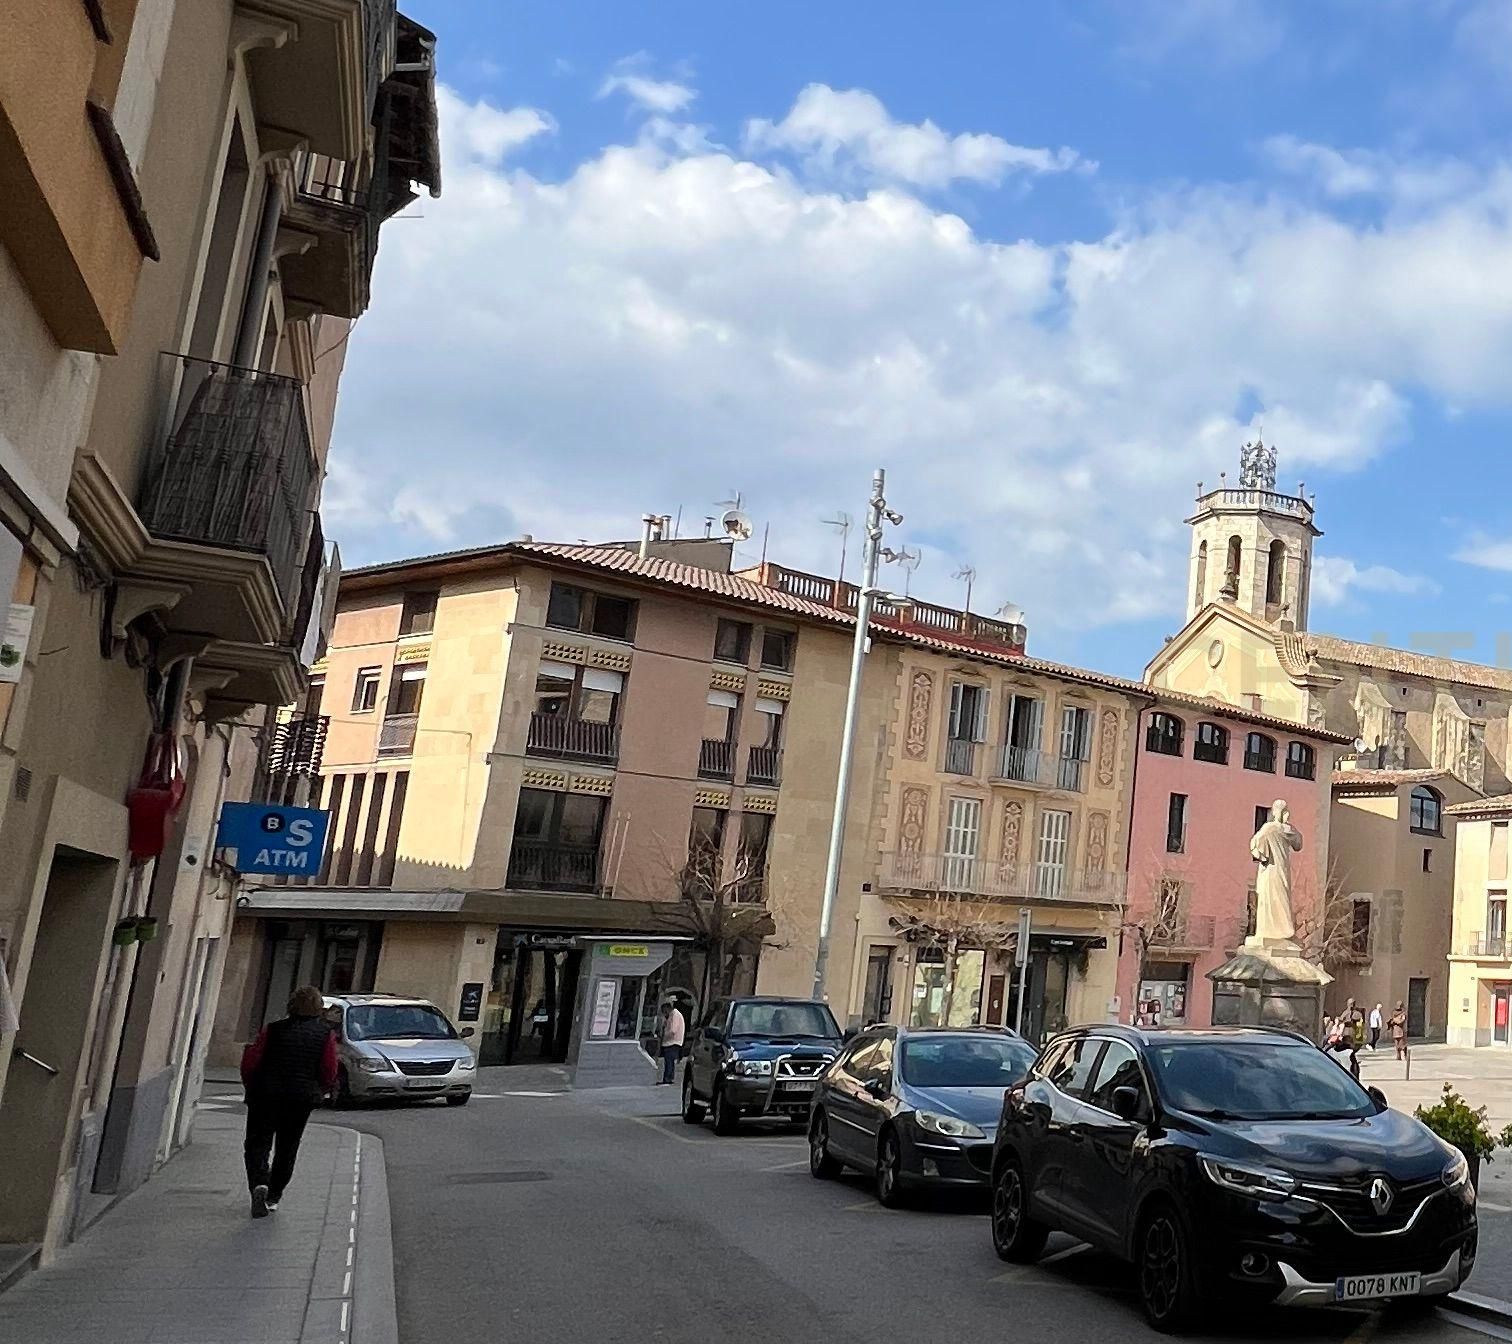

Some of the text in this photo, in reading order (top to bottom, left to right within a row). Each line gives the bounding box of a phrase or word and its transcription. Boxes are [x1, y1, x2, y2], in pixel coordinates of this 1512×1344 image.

[253, 848, 308, 869] ATM
[1346, 1274, 1418, 1297] 0078 KNT
